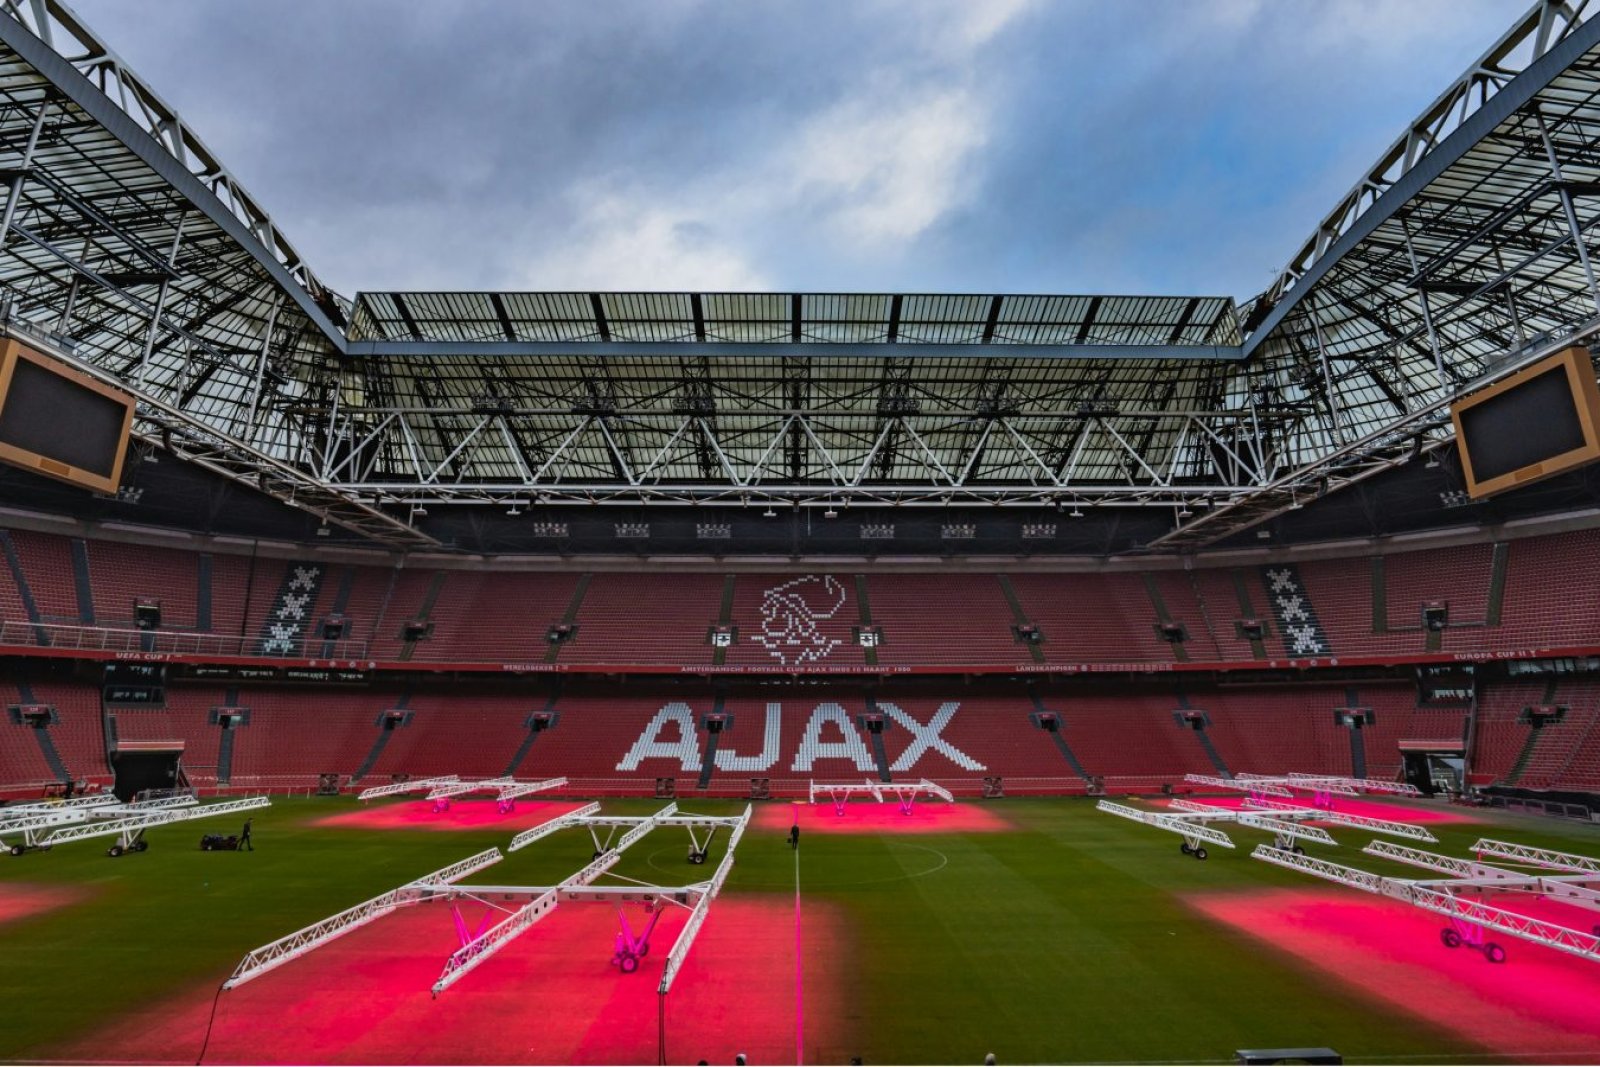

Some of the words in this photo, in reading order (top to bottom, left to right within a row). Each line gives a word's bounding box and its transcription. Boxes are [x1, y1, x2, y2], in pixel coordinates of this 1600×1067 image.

[115, 652, 141, 660] UEFA
[1453, 652, 1494, 660] EUROPA
[615, 702, 988, 772] AJAX
